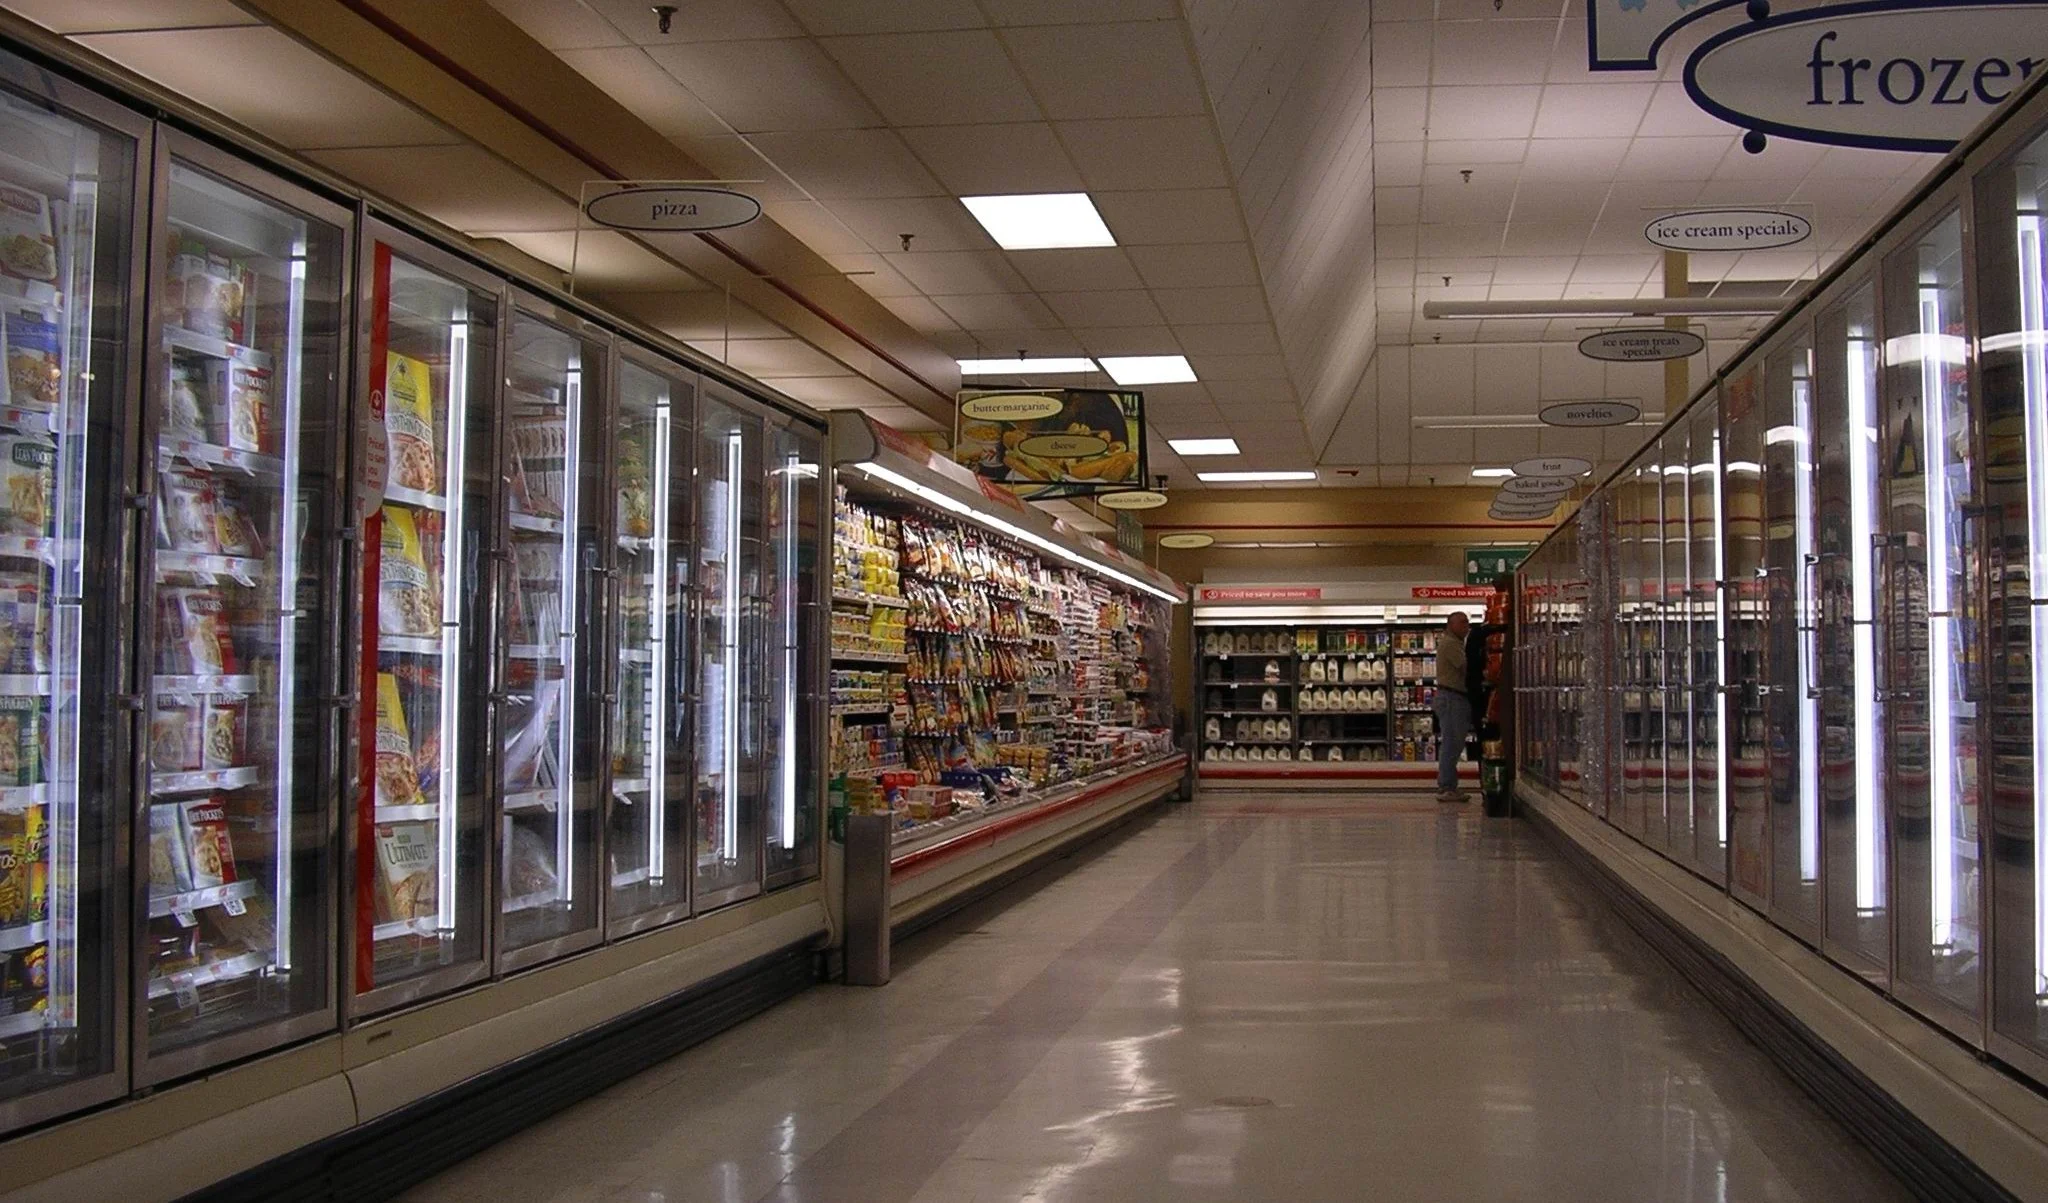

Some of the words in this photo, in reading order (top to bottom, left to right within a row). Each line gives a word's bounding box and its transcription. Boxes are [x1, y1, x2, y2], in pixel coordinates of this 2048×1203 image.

[652, 199, 698, 220] pizza
[1657, 223, 1680, 238] ice
[1684, 224, 1733, 238] cream
[1736, 220, 1799, 240] specials
[1602, 338, 1617, 347] ice
[1619, 338, 1649, 347] cream
[1652, 337, 1680, 347] treats
[1622, 346, 1661, 358] specials
[1567, 408, 1613, 419] novelties
[1050, 441, 1077, 450] cheese
[1272, 592, 1286, 600] you
[385, 843, 428, 865] ULTIMATE
